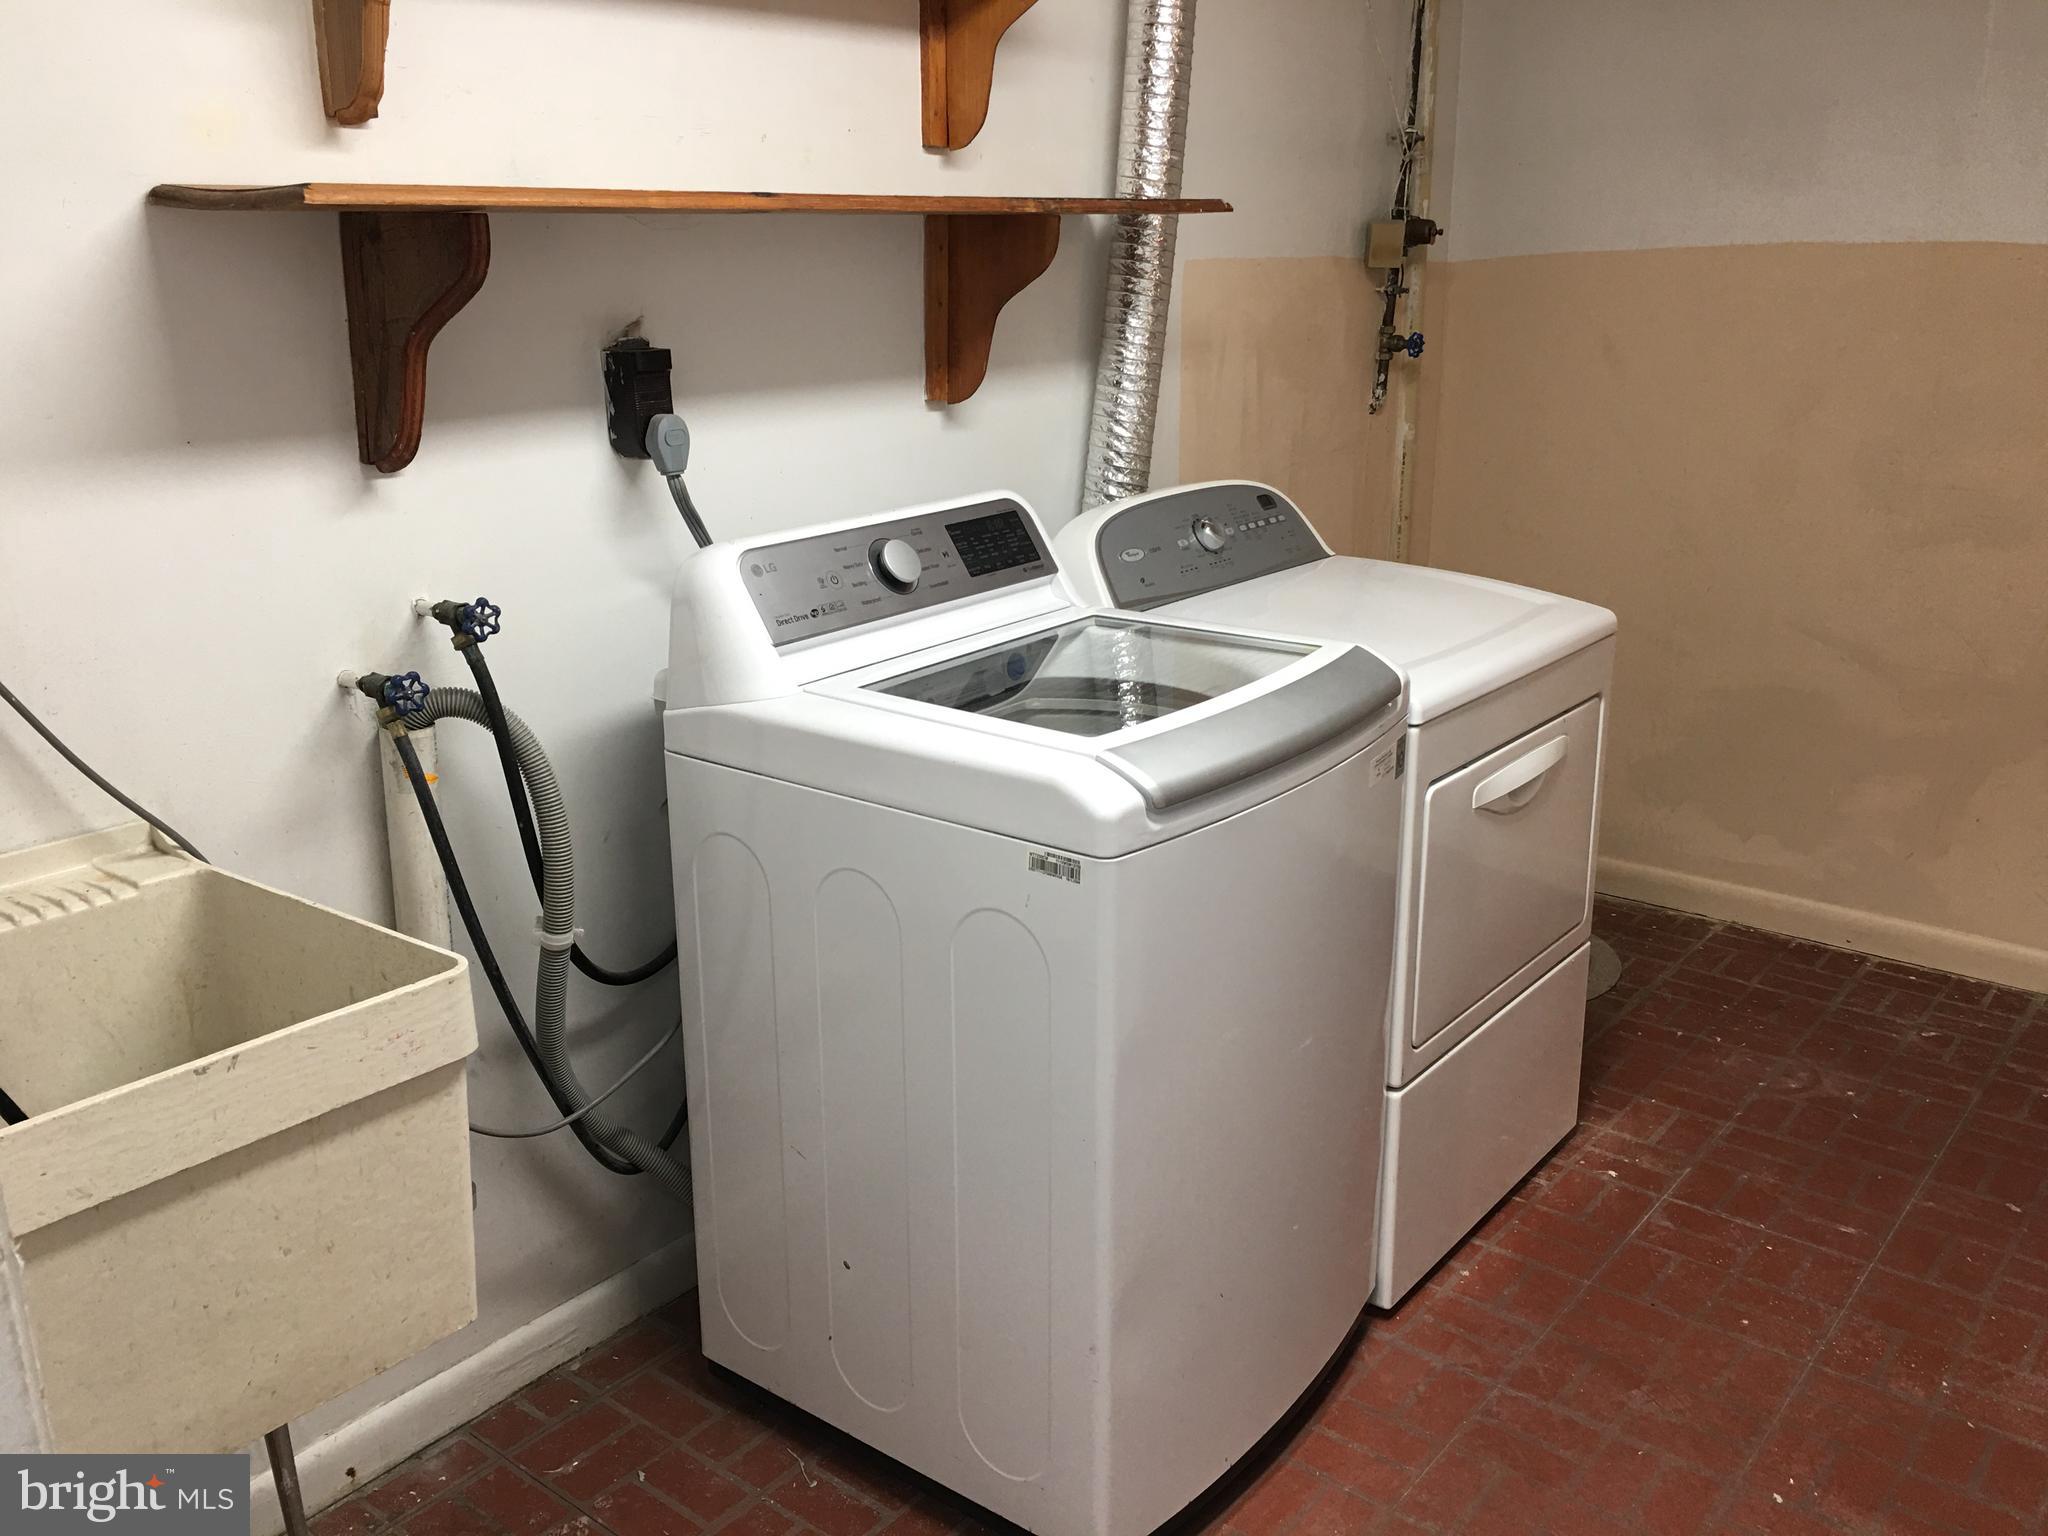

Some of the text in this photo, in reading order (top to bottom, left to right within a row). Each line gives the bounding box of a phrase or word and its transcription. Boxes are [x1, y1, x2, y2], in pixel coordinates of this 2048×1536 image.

[763, 563, 778, 574] LG
[775, 616, 795, 627] Direct
[793, 613, 809, 623] Drive
